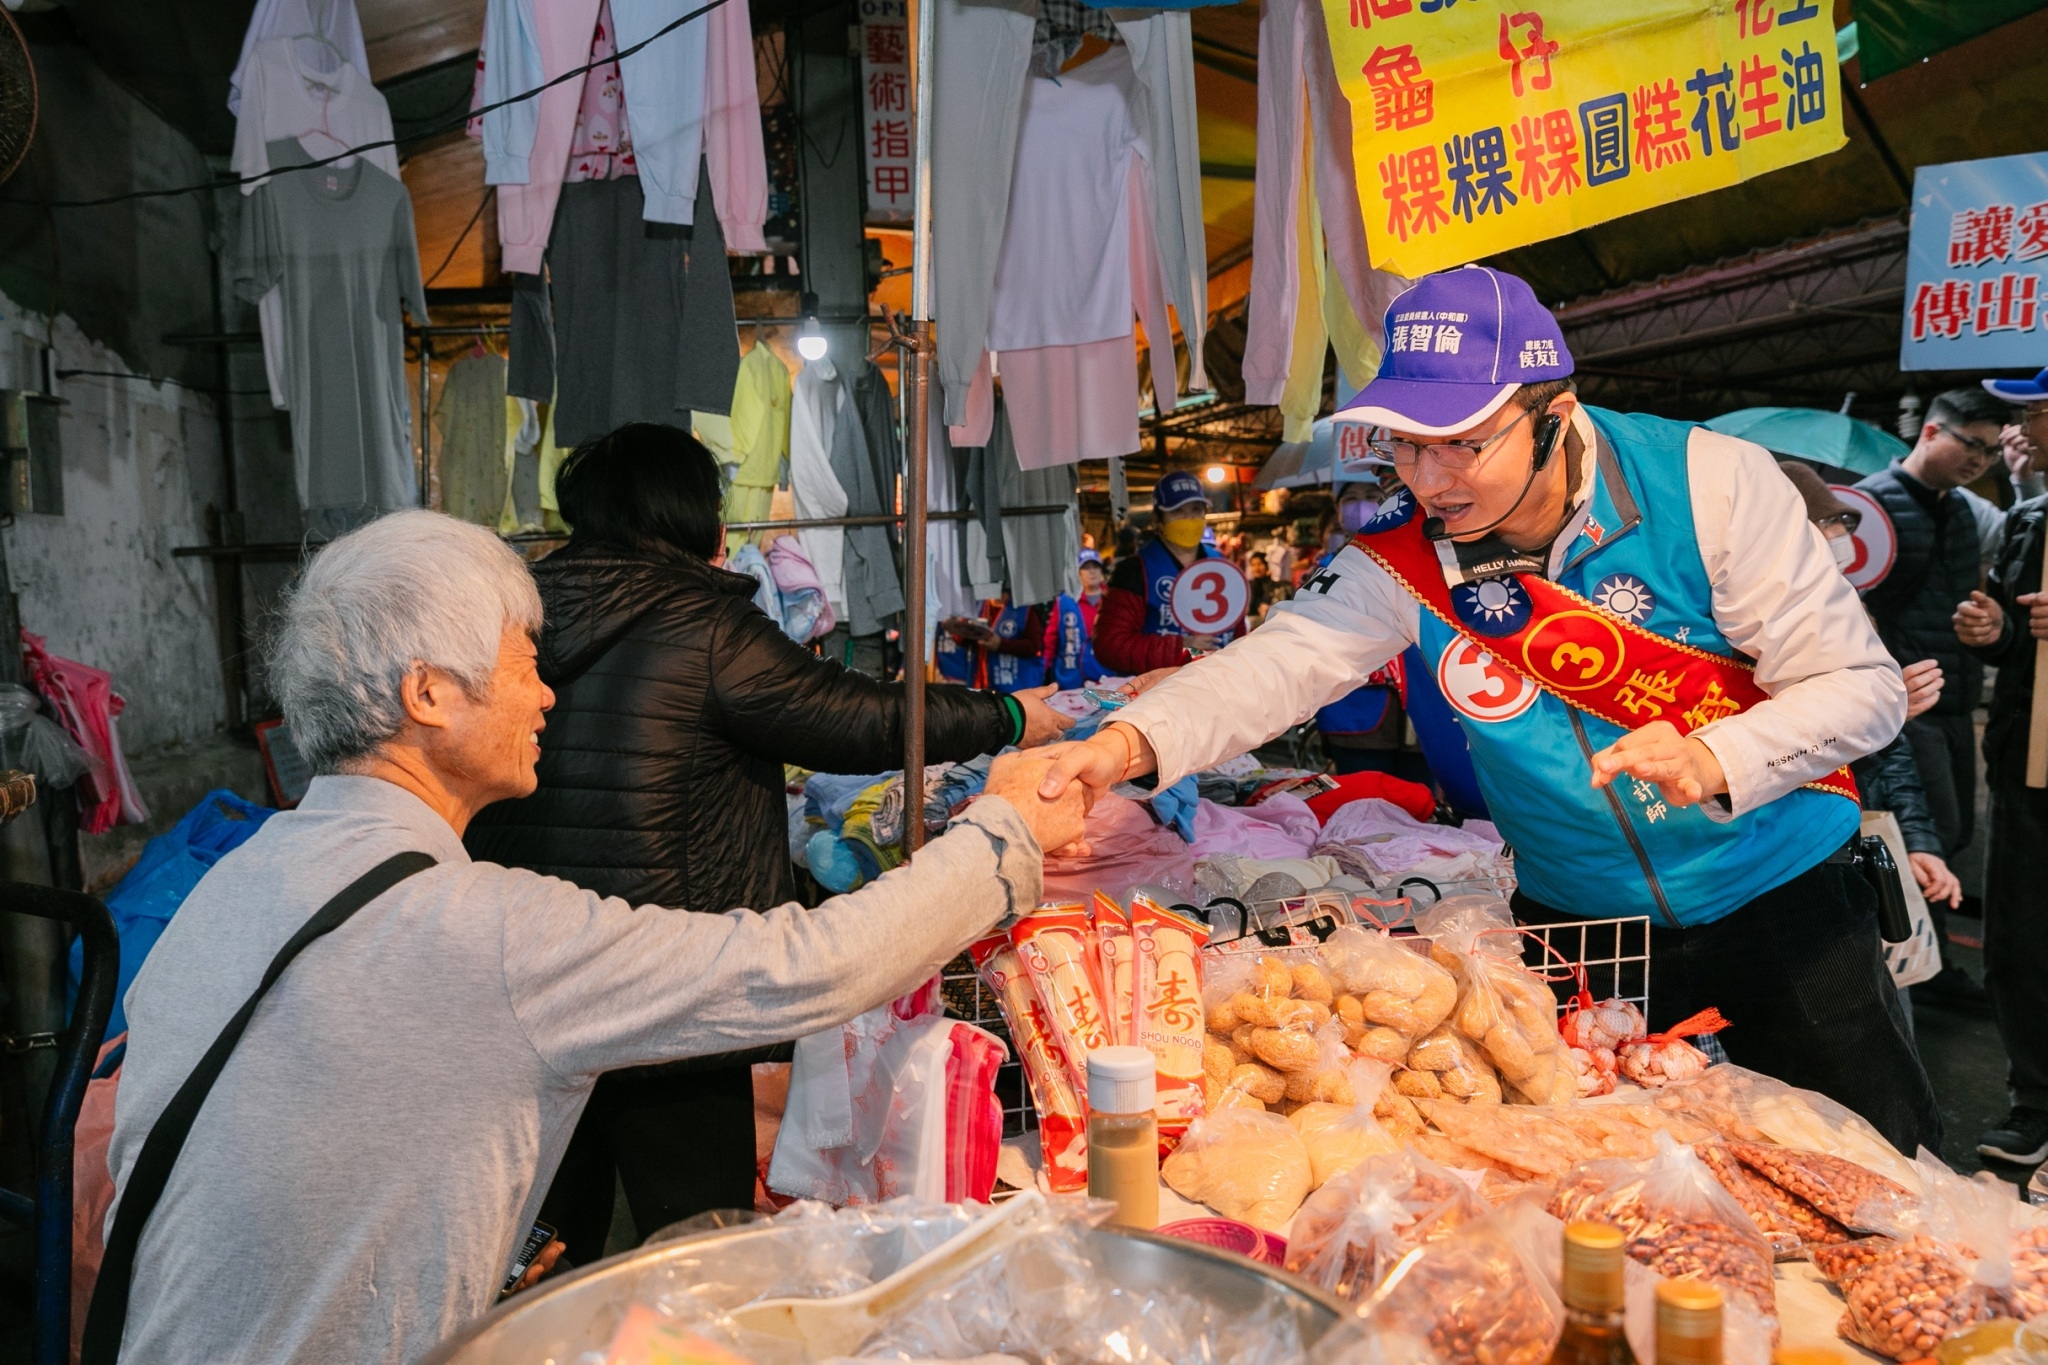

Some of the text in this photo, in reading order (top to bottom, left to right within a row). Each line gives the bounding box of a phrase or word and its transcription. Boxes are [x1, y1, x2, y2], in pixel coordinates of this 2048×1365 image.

[865, 24, 910, 204] 藝術指甲
[1910, 275, 2048, 341] 傳出
[1392, 324, 1463, 355] 張智倫
[1519, 350, 1560, 369] 侯友宜
[1473, 560, 1504, 574] HELLY
[1190, 571, 1230, 624] 3
[1459, 644, 1523, 708] 3
[1551, 642, 1604, 679] 3
[1767, 749, 1808, 768] HANSEN
[1631, 776, 1667, 824] 計師
[1140, 1031, 1170, 1043] SHOU
